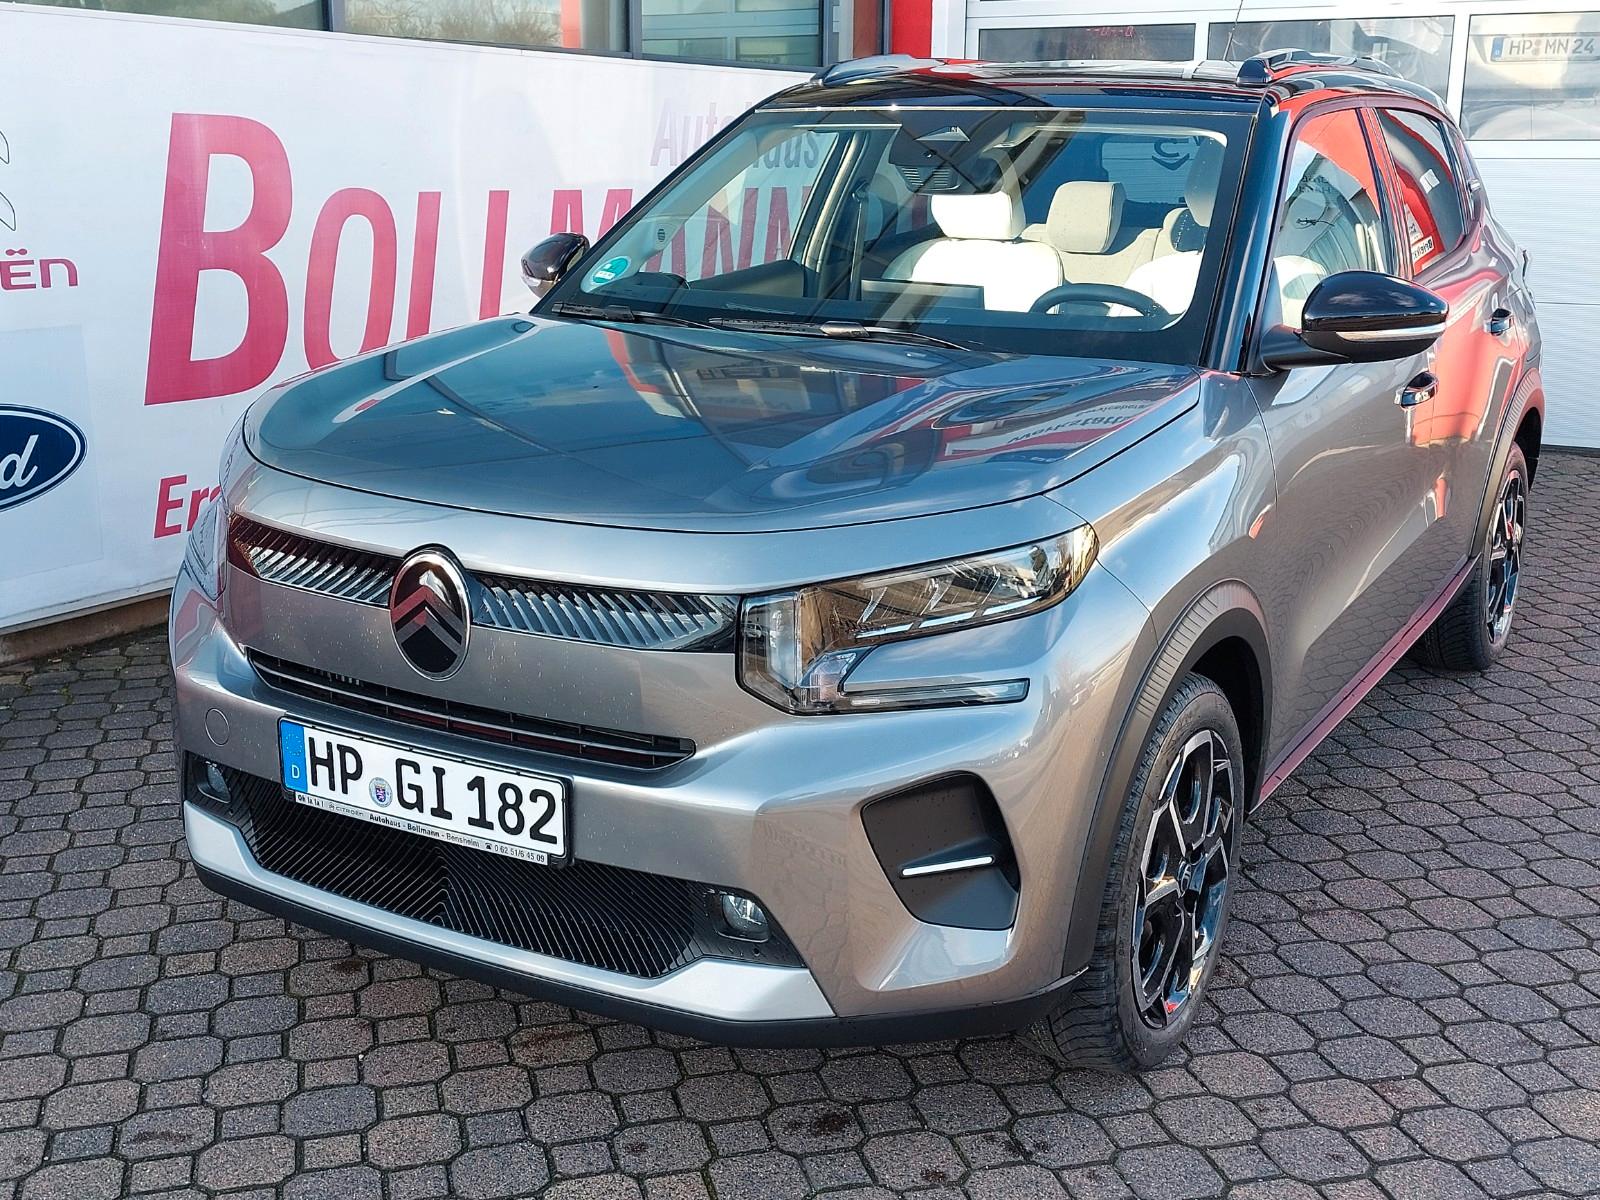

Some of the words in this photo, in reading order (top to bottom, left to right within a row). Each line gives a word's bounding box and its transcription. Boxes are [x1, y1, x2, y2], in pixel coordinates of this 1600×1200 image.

[1509, 40, 1533, 55] HP
[1544, 38, 1569, 54] MN
[1572, 38, 1595, 54] 24
[291, 765, 300, 779] D
[308, 736, 363, 795] HP
[395, 757, 453, 820] GI
[467, 775, 558, 845] 182
[369, 814, 401, 828] Autohaus
[407, 823, 440, 837] Bollmann
